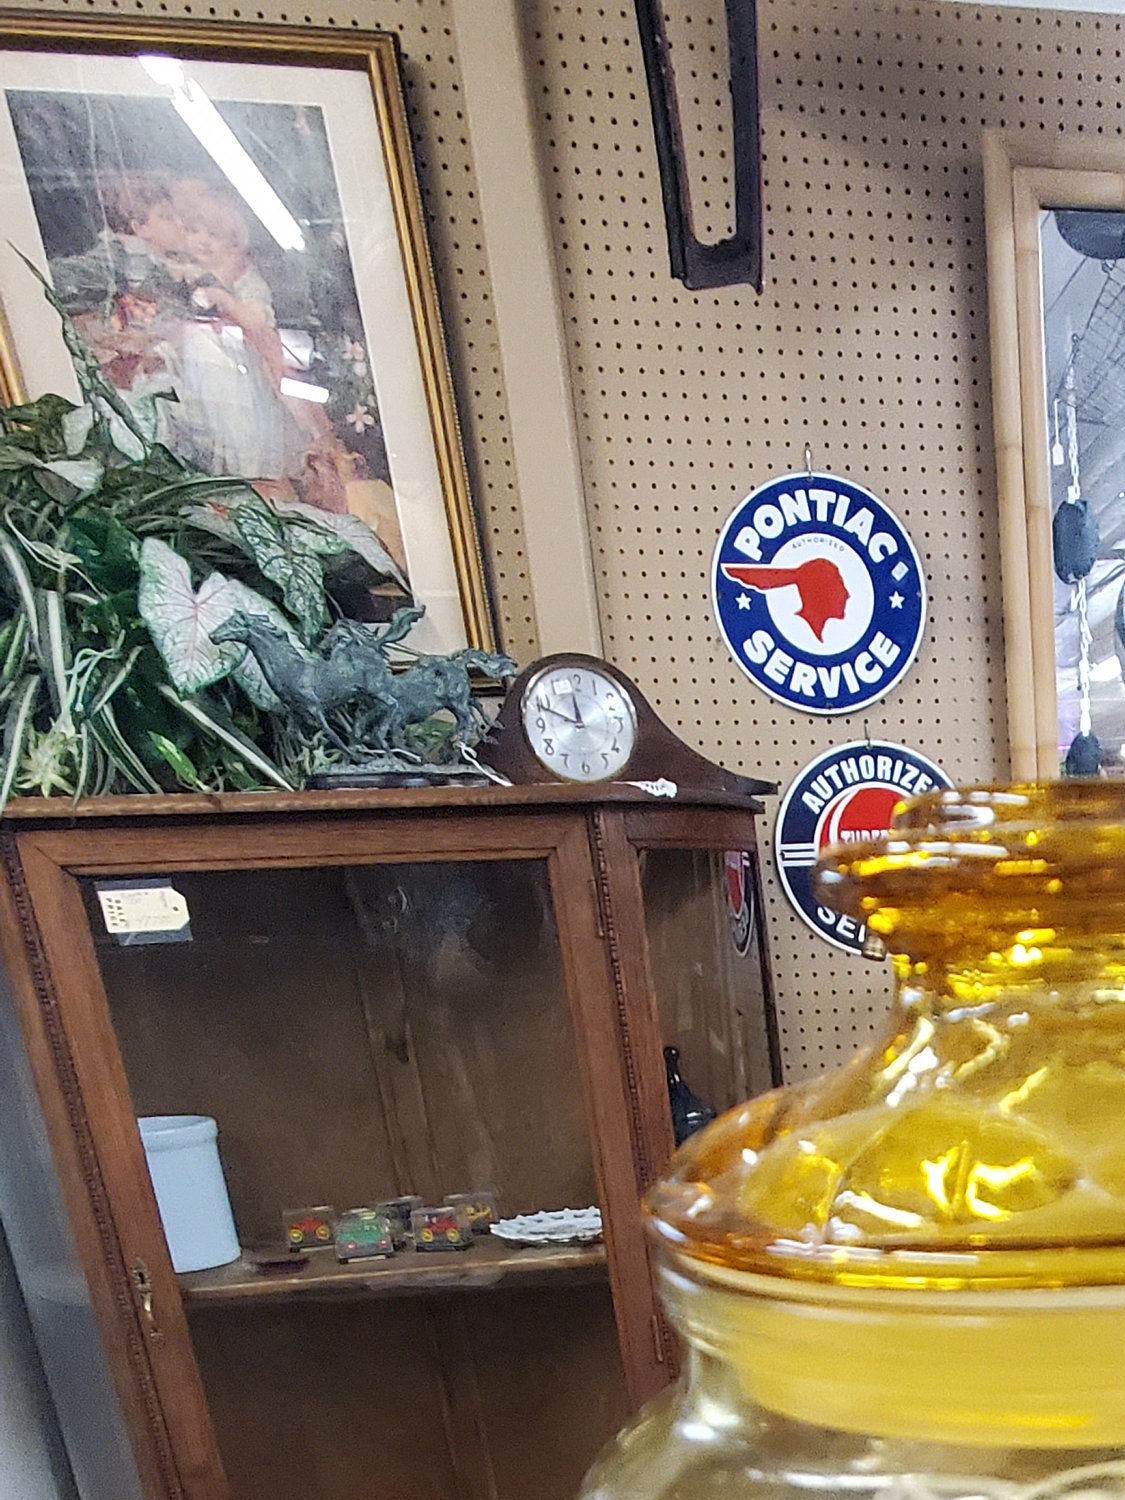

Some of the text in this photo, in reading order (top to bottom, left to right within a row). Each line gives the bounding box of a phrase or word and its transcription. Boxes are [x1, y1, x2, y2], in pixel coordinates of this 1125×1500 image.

[733, 489, 898, 563] PONTIAC
[742, 629, 901, 698] SERVICE
[536, 717, 546, 734] 9
[543, 738, 555, 755] 8
[611, 736, 620, 753] 4
[560, 753, 569, 769] 7
[581, 760, 591, 775] 6
[801, 754, 941, 815] AUTHORIZE
